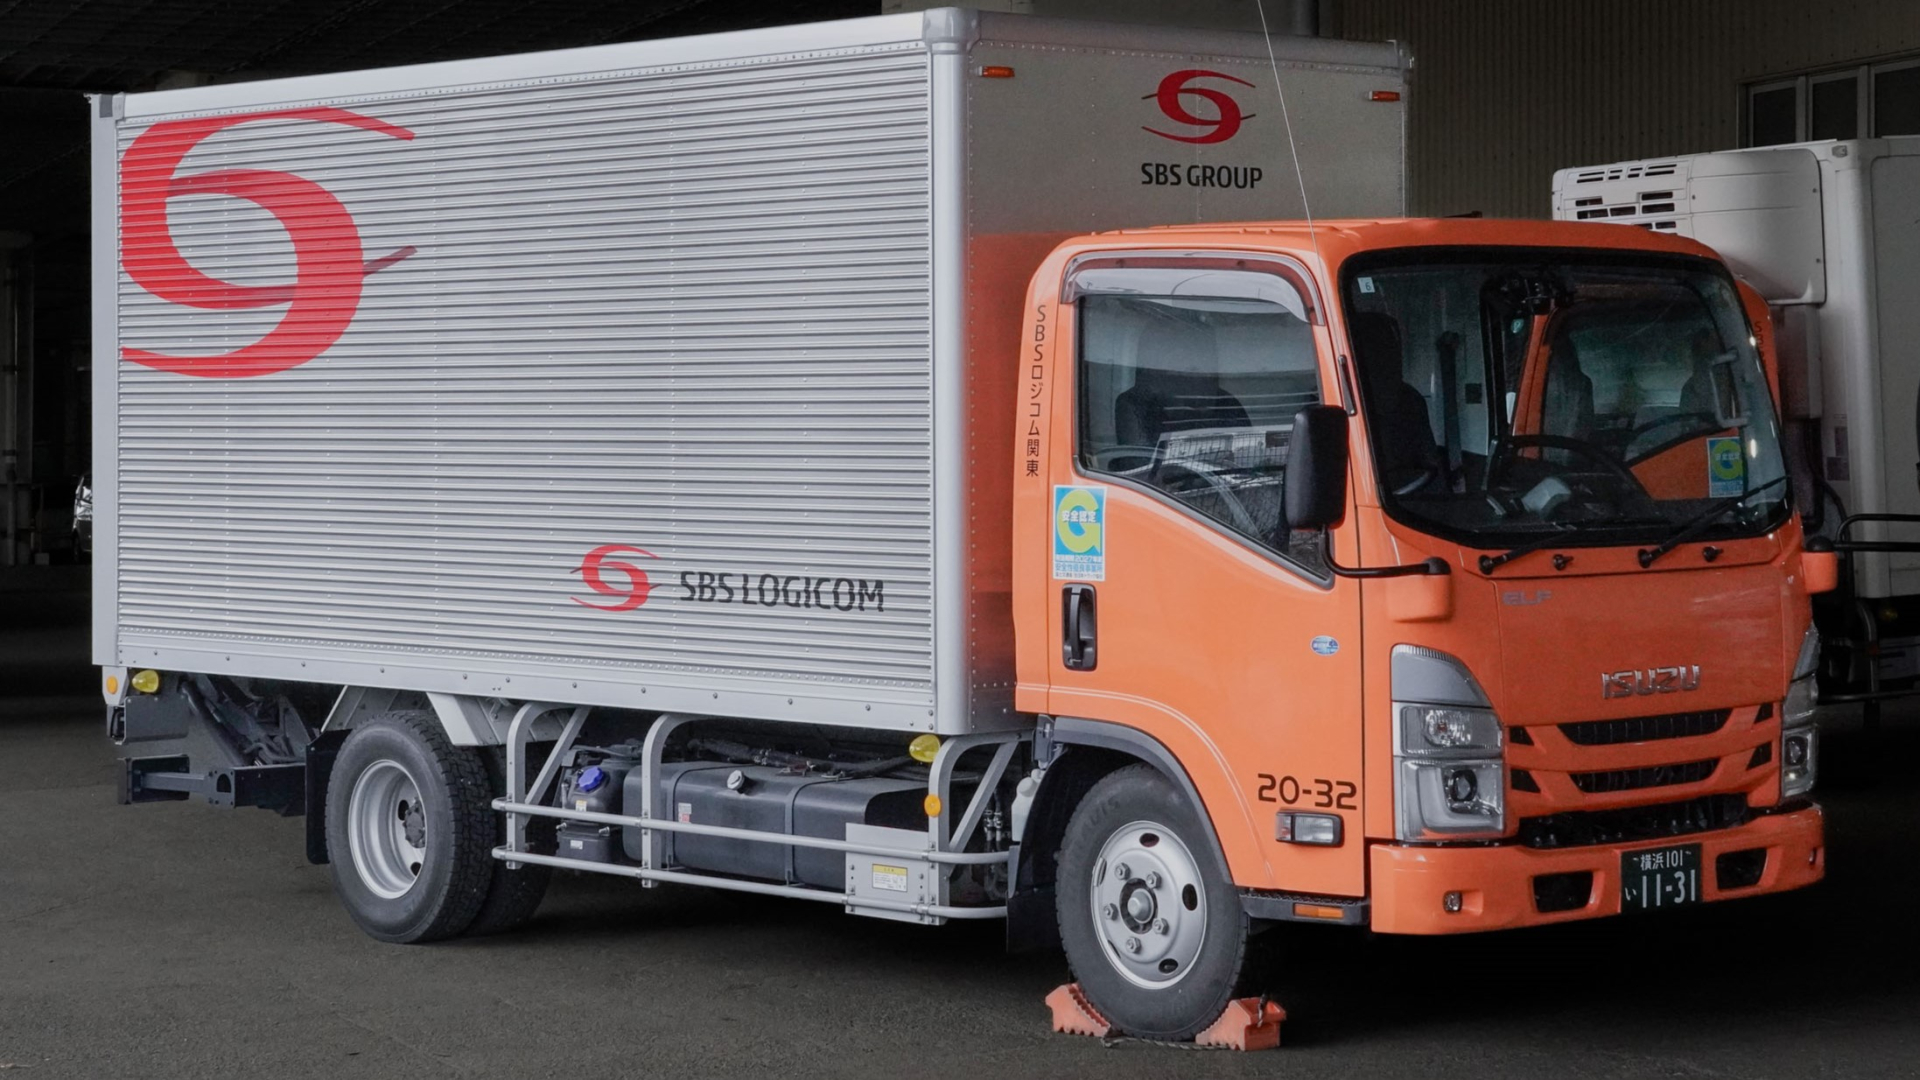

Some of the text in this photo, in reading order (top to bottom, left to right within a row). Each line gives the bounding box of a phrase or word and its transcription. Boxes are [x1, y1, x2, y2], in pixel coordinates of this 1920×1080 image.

[1141, 162, 1263, 189] SBS GROUP
[1025, 304, 1046, 477] SBSロジコム関東
[680, 570, 885, 612] SBS LOGICOM
[1602, 664, 1700, 699] ISUZU
[1257, 773, 1357, 810] 20-32
[1640, 849, 1683, 871] 横浜 101
[1642, 869, 1696, 908] 11-31
